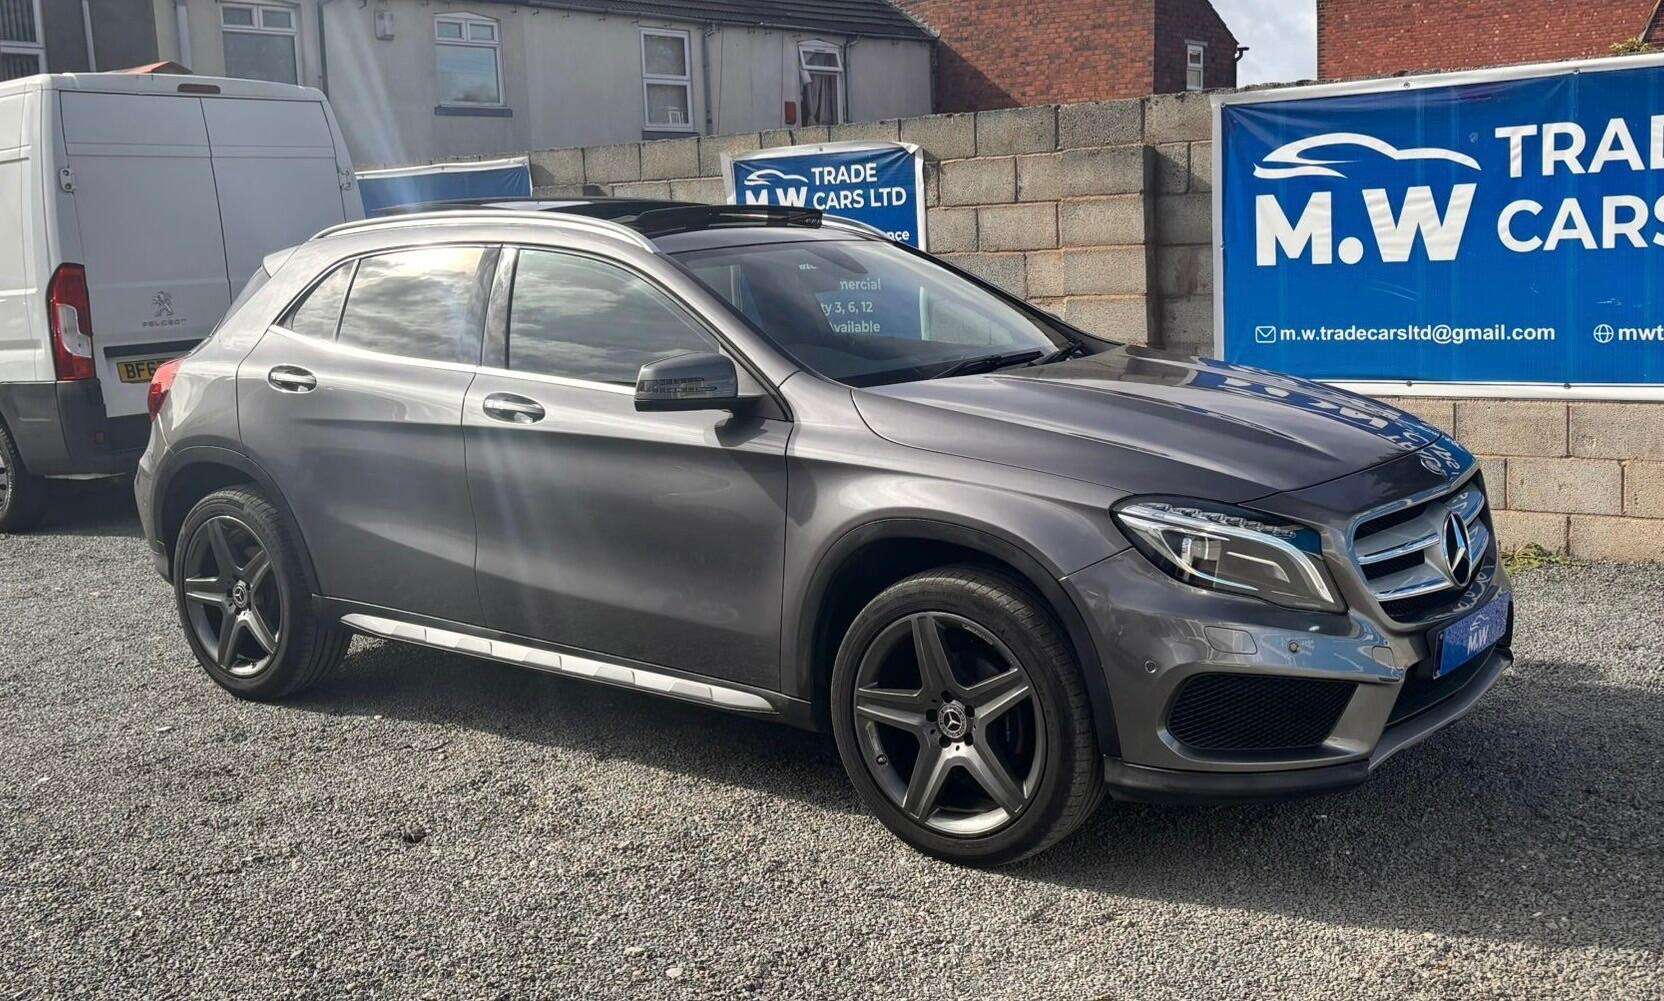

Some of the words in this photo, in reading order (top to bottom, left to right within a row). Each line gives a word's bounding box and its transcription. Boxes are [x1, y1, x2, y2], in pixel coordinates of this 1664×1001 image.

[1495, 113, 1664, 178] TRA
[811, 163, 878, 186] TRADE
[745, 186, 808, 208] MW
[813, 189, 865, 210] CARS
[870, 187, 907, 207] LTD
[1255, 182, 1477, 267] M.W
[886, 230, 910, 241] nce
[820, 302, 832, 316] ty
[834, 301, 845, 314] 3,
[848, 301, 859, 314] 6,
[861, 301, 874, 313] 12
[142, 318, 188, 328] PEUGEOT
[829, 320, 881, 333] vailable
[1280, 324, 1556, 344] m.w.tradecarsltd@gmail.com
